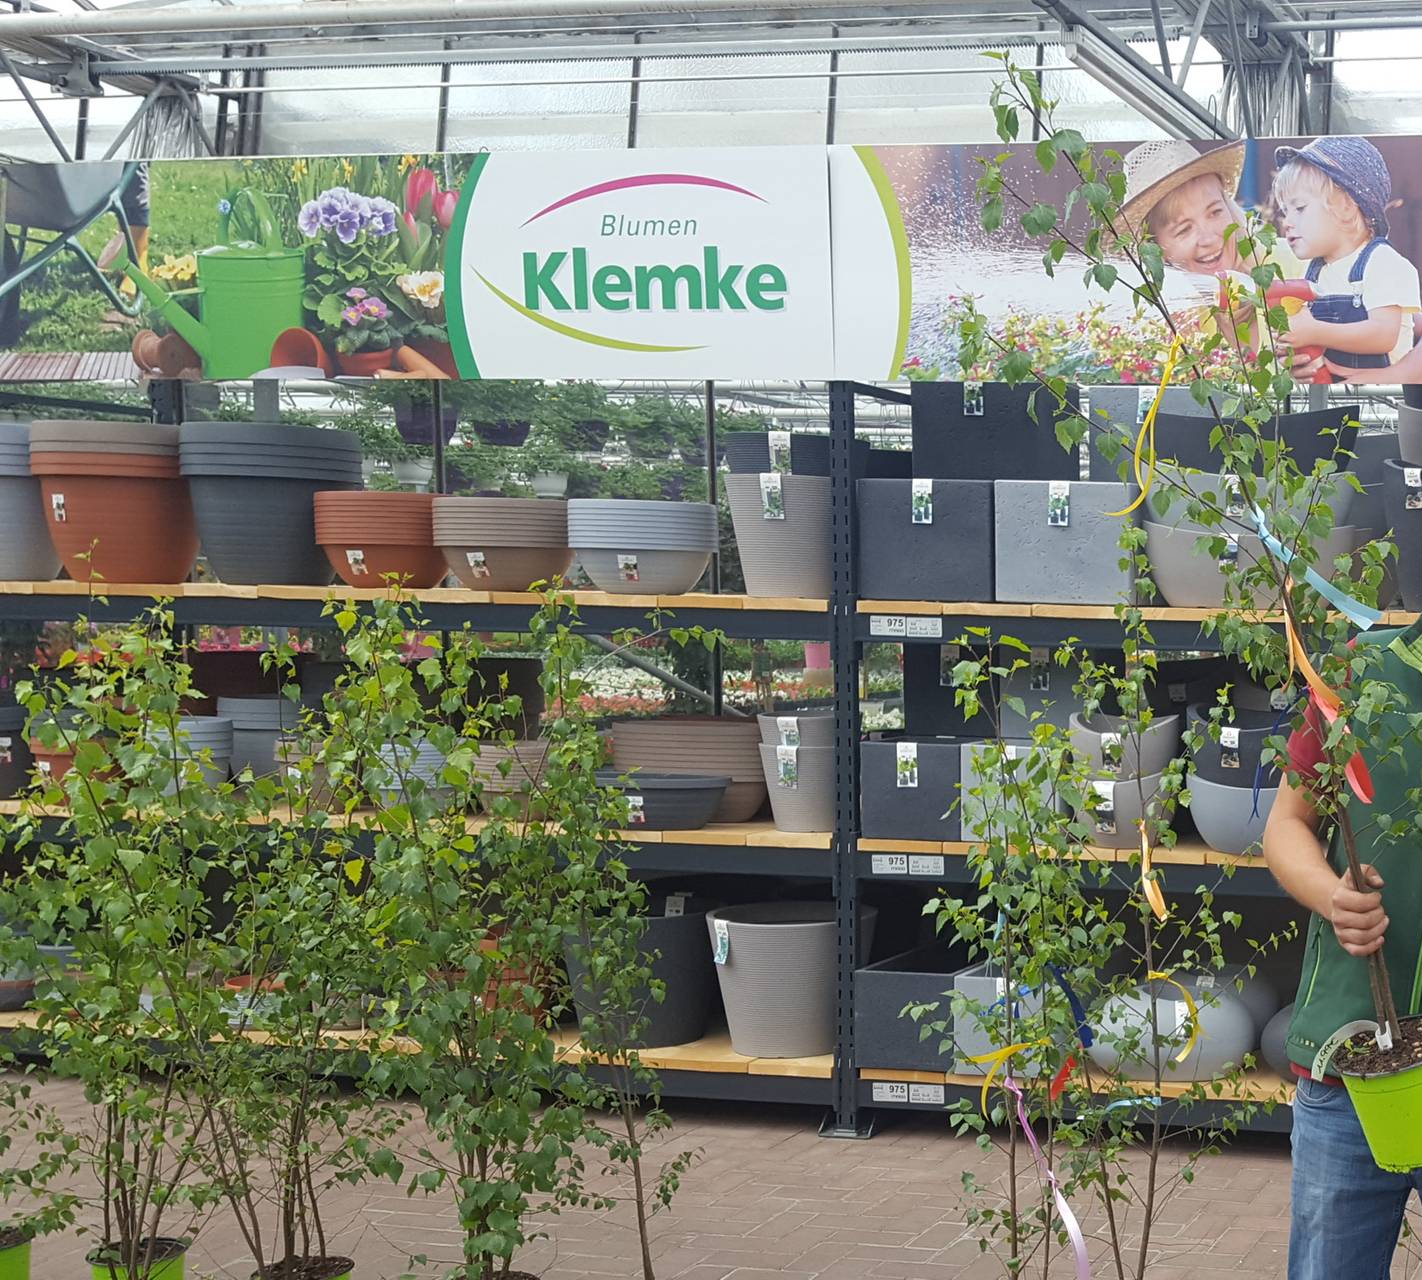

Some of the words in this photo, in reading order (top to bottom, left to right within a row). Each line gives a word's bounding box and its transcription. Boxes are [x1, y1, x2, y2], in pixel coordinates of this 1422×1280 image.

[600, 214, 698, 237] Blumen
[522, 245, 789, 312] Klemke
[887, 618, 904, 628] 975
[888, 856, 905, 866] 975
[889, 1084, 905, 1093] 975
